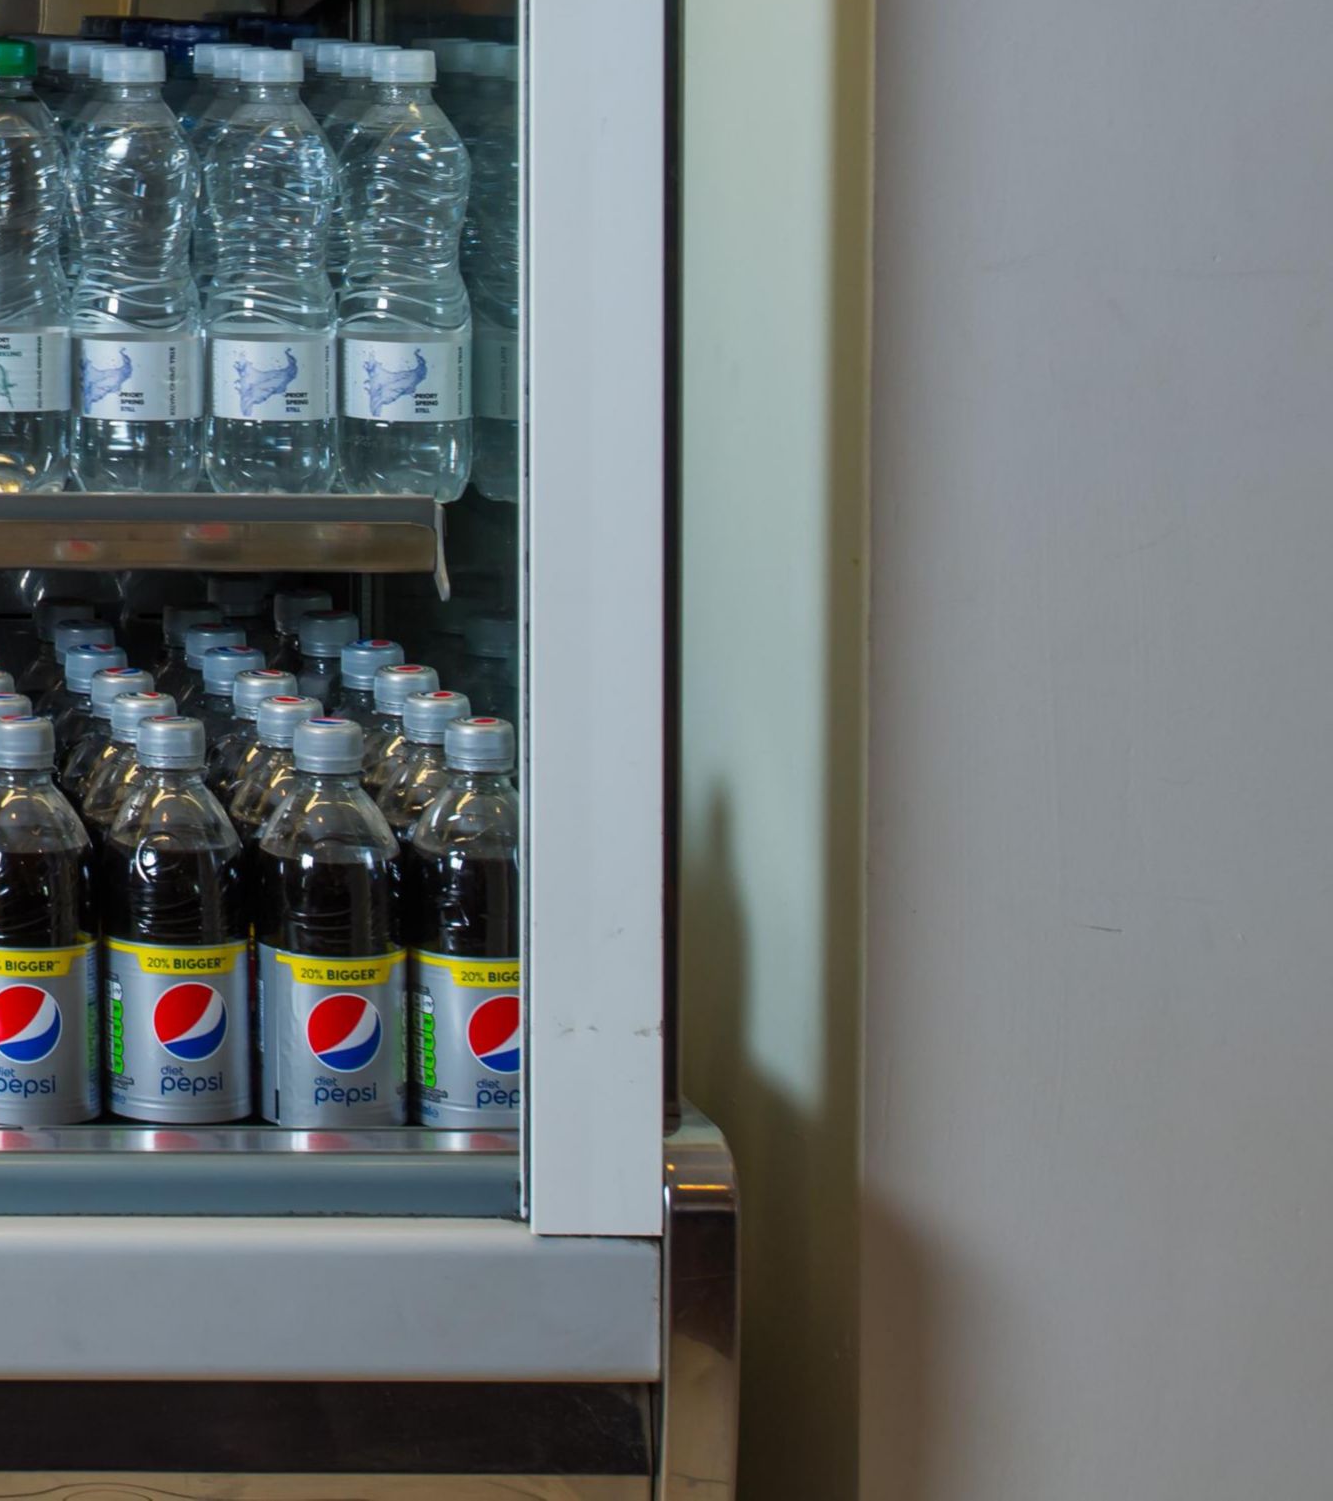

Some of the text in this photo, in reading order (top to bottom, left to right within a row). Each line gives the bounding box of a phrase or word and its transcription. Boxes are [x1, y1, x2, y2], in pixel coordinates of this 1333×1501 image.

[5, 959, 54, 973] BIGGER
[146, 955, 222, 970] 20% BIGGER
[300, 967, 377, 981] 20% BIGGER
[460, 970, 485, 983] 20%
[160, 1064, 184, 1077] diet
[160, 1071, 224, 1096] pepsi
[313, 1075, 338, 1088] diet
[475, 1078, 500, 1090] diet
[314, 1082, 378, 1107] pepsi
